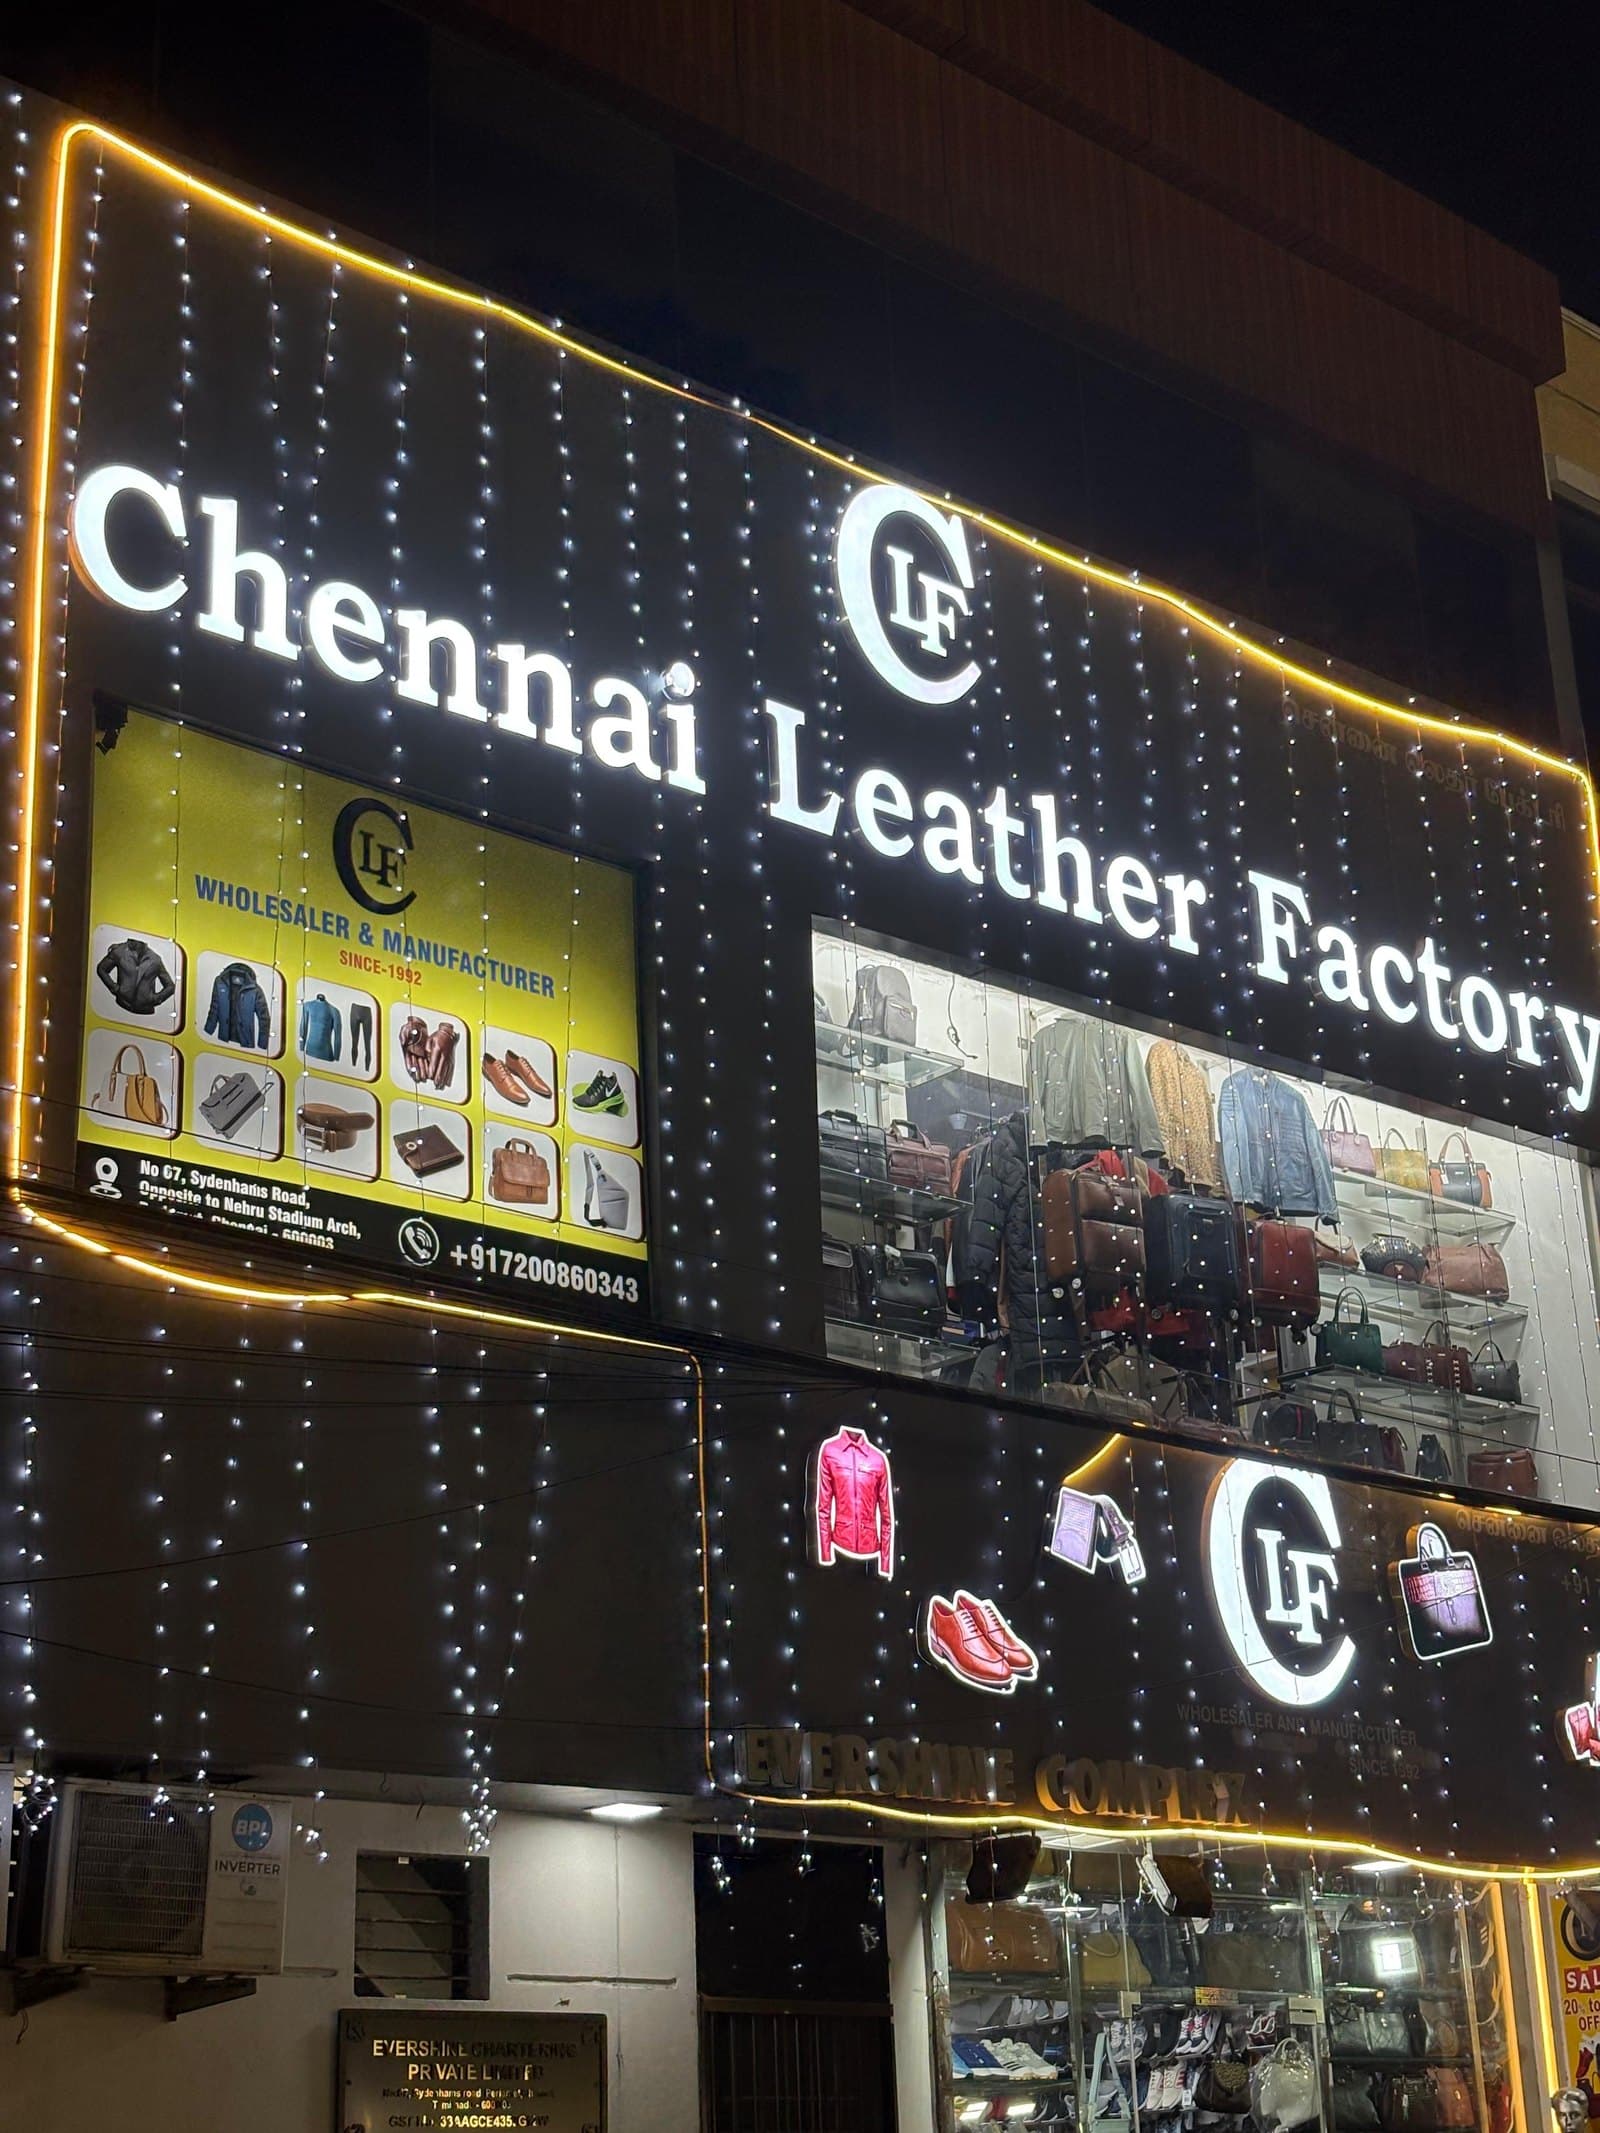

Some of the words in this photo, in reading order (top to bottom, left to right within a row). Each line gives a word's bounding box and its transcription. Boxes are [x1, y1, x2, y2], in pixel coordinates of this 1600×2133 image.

[70, 464, 706, 795] Chennai
[764, 698, 1207, 958] Leather
[1247, 869, 1600, 1113] Factory
[195, 874, 350, 940] WHOLESALER
[358, 921, 374, 948] &
[383, 928, 555, 999] MANUFACTURER
[339, 949, 422, 987] SINCE-1992
[140, 1159, 159, 1177] No
[163, 1164, 186, 1185] 67,
[190, 1169, 268, 1200] Sydenhams
[271, 1184, 311, 1210] Road,
[139, 1180, 201, 1205] Opposite
[205, 1193, 220, 1209] to
[224, 1196, 264, 1219] Nehru
[268, 1205, 324, 1230] Stadium
[327, 1217, 361, 1240] Arch,
[450, 1243, 639, 1303] +917200860343
[1177, 1703, 1274, 1729] WHOLESALER
[1278, 1713, 1304, 1731] AND
[1310, 1719, 1417, 1746] MANUFACTURER
[738, 1725, 1014, 1804] EVERSHINE
[1349, 1759, 1388, 1777] SINCE
[215, 1859, 281, 1875] INVERTER
[373, 2039, 468, 2057] EVERSHINE
[407, 2063, 477, 2081] PRIVATE
